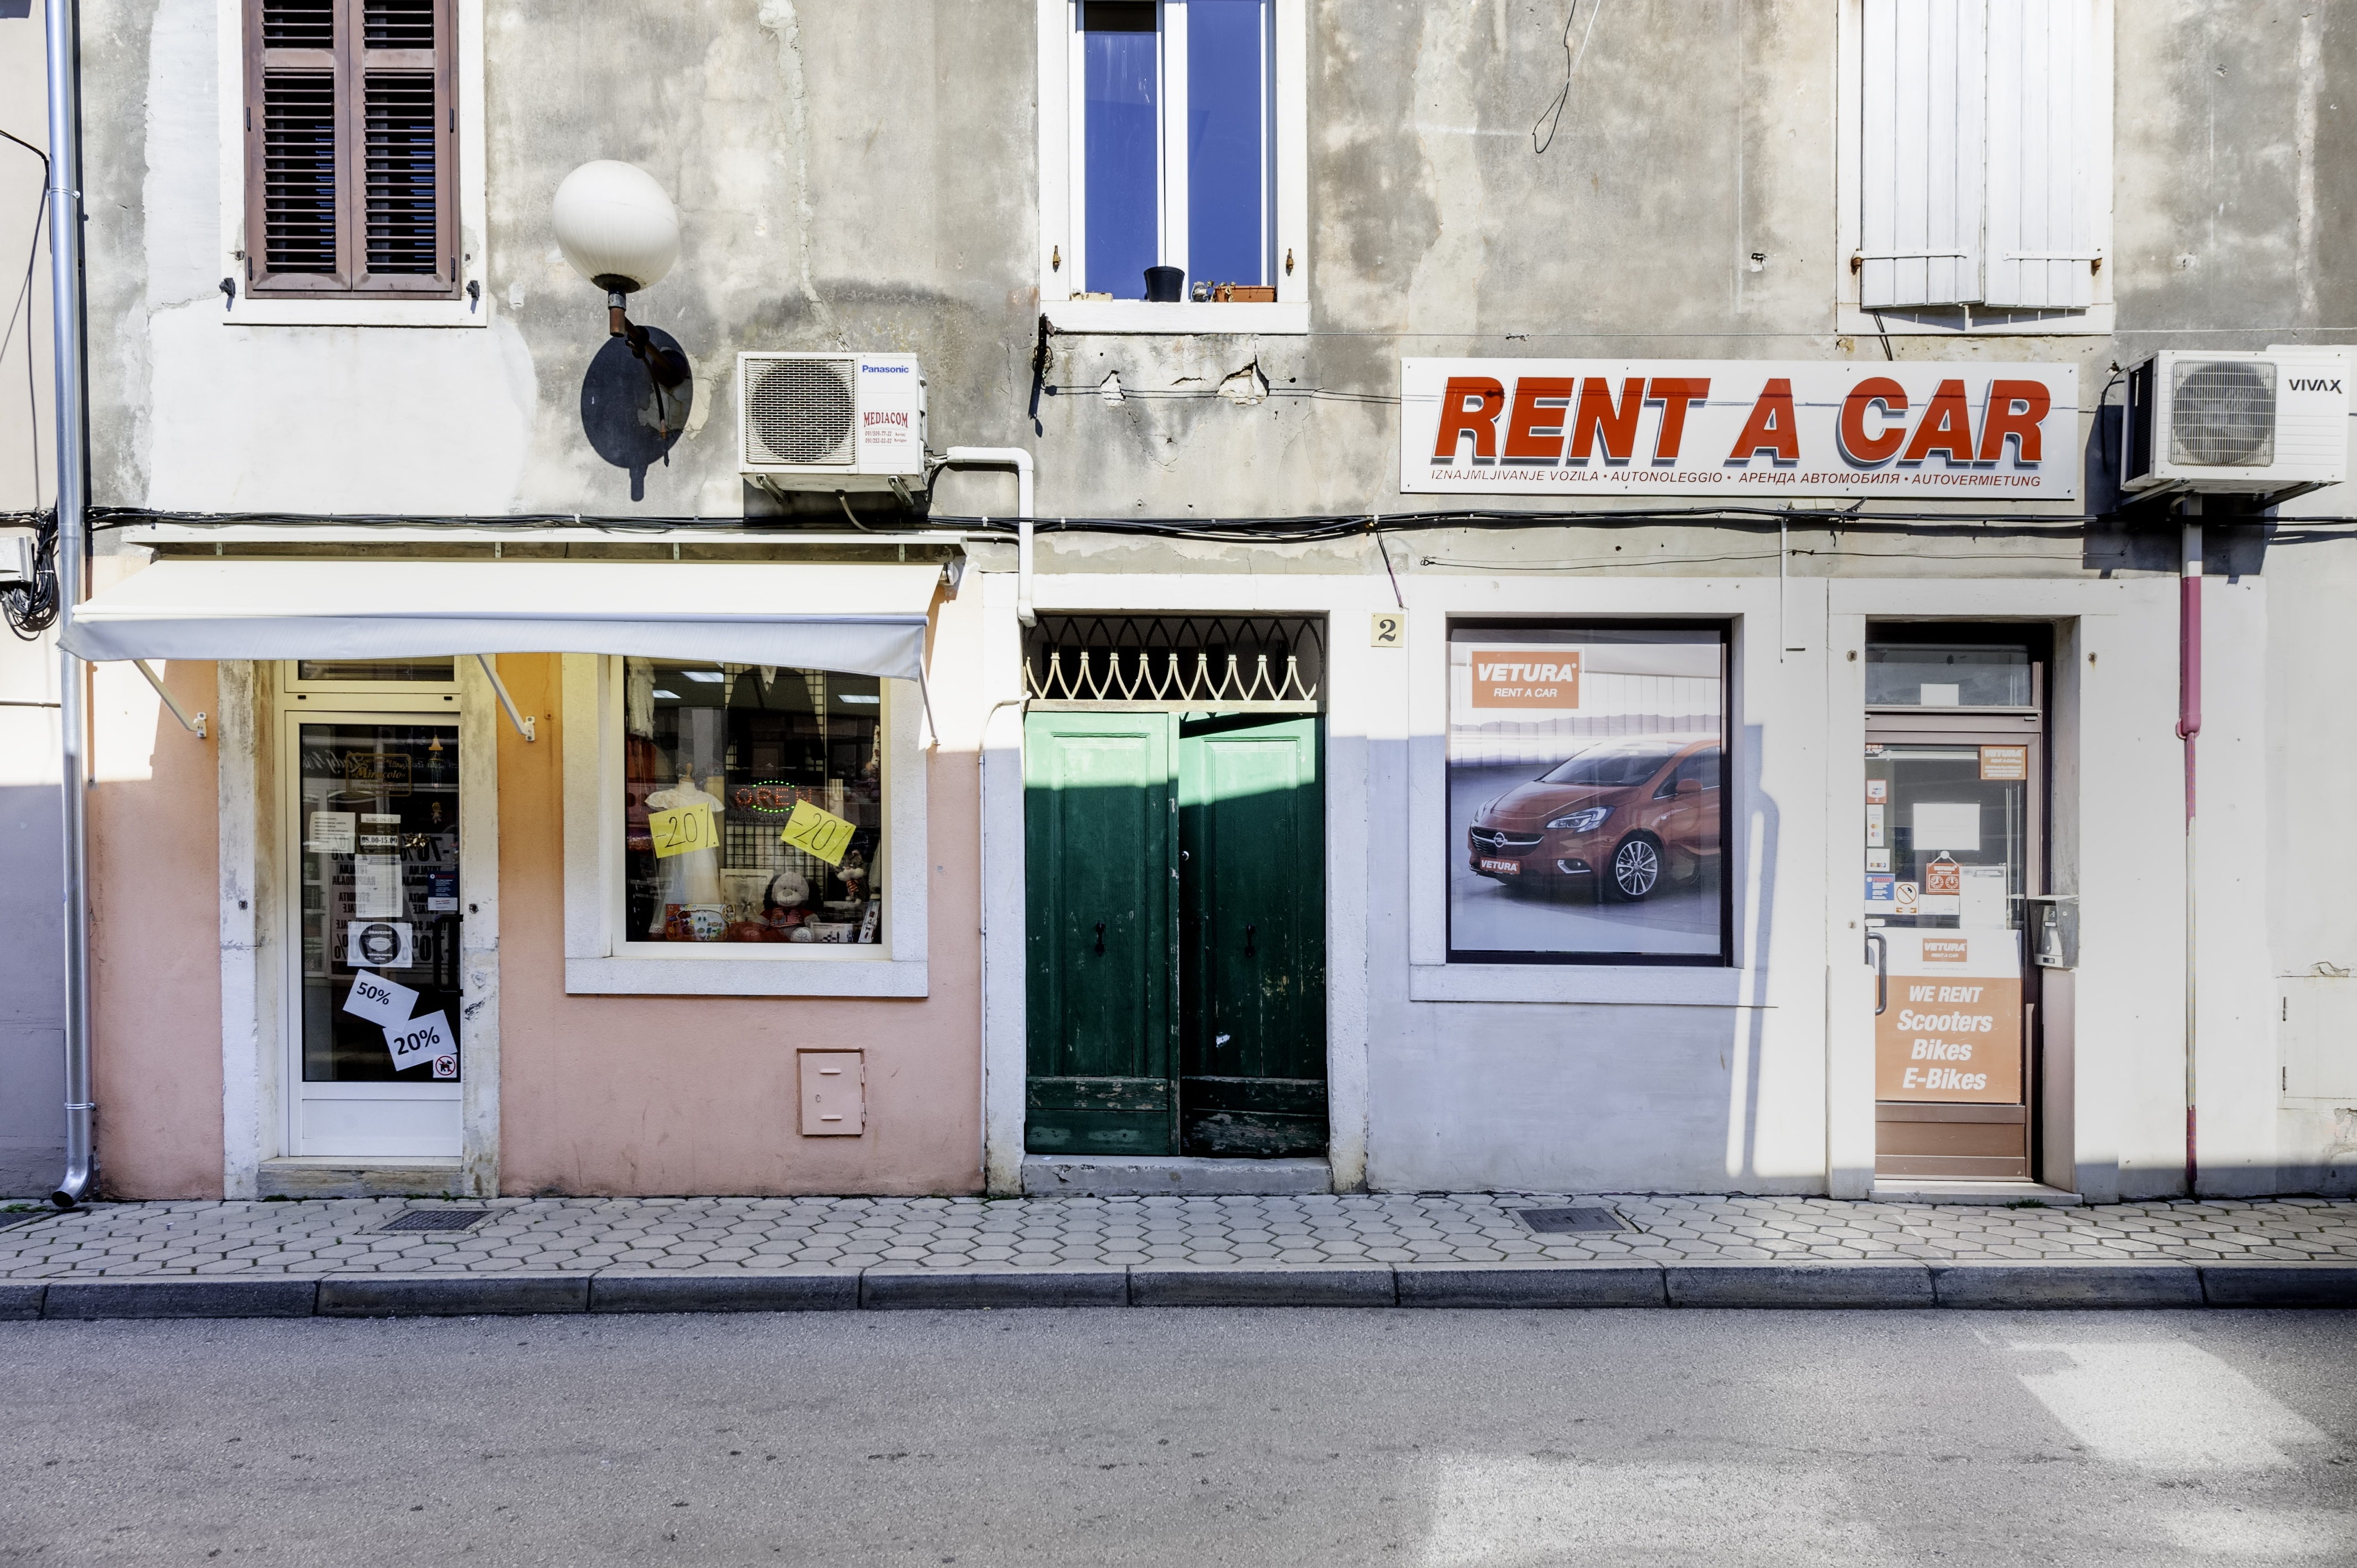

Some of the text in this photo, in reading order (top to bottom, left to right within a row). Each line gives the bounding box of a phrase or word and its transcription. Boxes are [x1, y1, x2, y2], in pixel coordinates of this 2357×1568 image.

[2289, 379, 2342, 394] VIVAX
[863, 412, 908, 429] MEDIACOM
[1432, 376, 2051, 464] RENT A CAR
[1431, 470, 1723, 483] IZNAJMLJIVANJE VOZILA AUTONOLEGGIO
[1739, 473, 1900, 485] АРЕНДА АВТОМОБИЛЯ
[1912, 474, 2041, 487] AUTOVERMIETUNG
[1378, 619, 1396, 642] 2
[1477, 663, 1574, 683] VETURA
[1493, 688, 1558, 698] RENT A CAR
[736, 787, 812, 806] OPEN
[1480, 859, 1517, 872] VETURA
[1924, 942, 1965, 952] VETURA
[356, 982, 392, 1005] 50%
[1908, 986, 1984, 1003] WE RENT
[1897, 1009, 1993, 1033] Scooters
[393, 1026, 441, 1056] 20%
[1911, 1039, 1973, 1061] Bikes
[1902, 1067, 1987, 1090] E-Bikes
